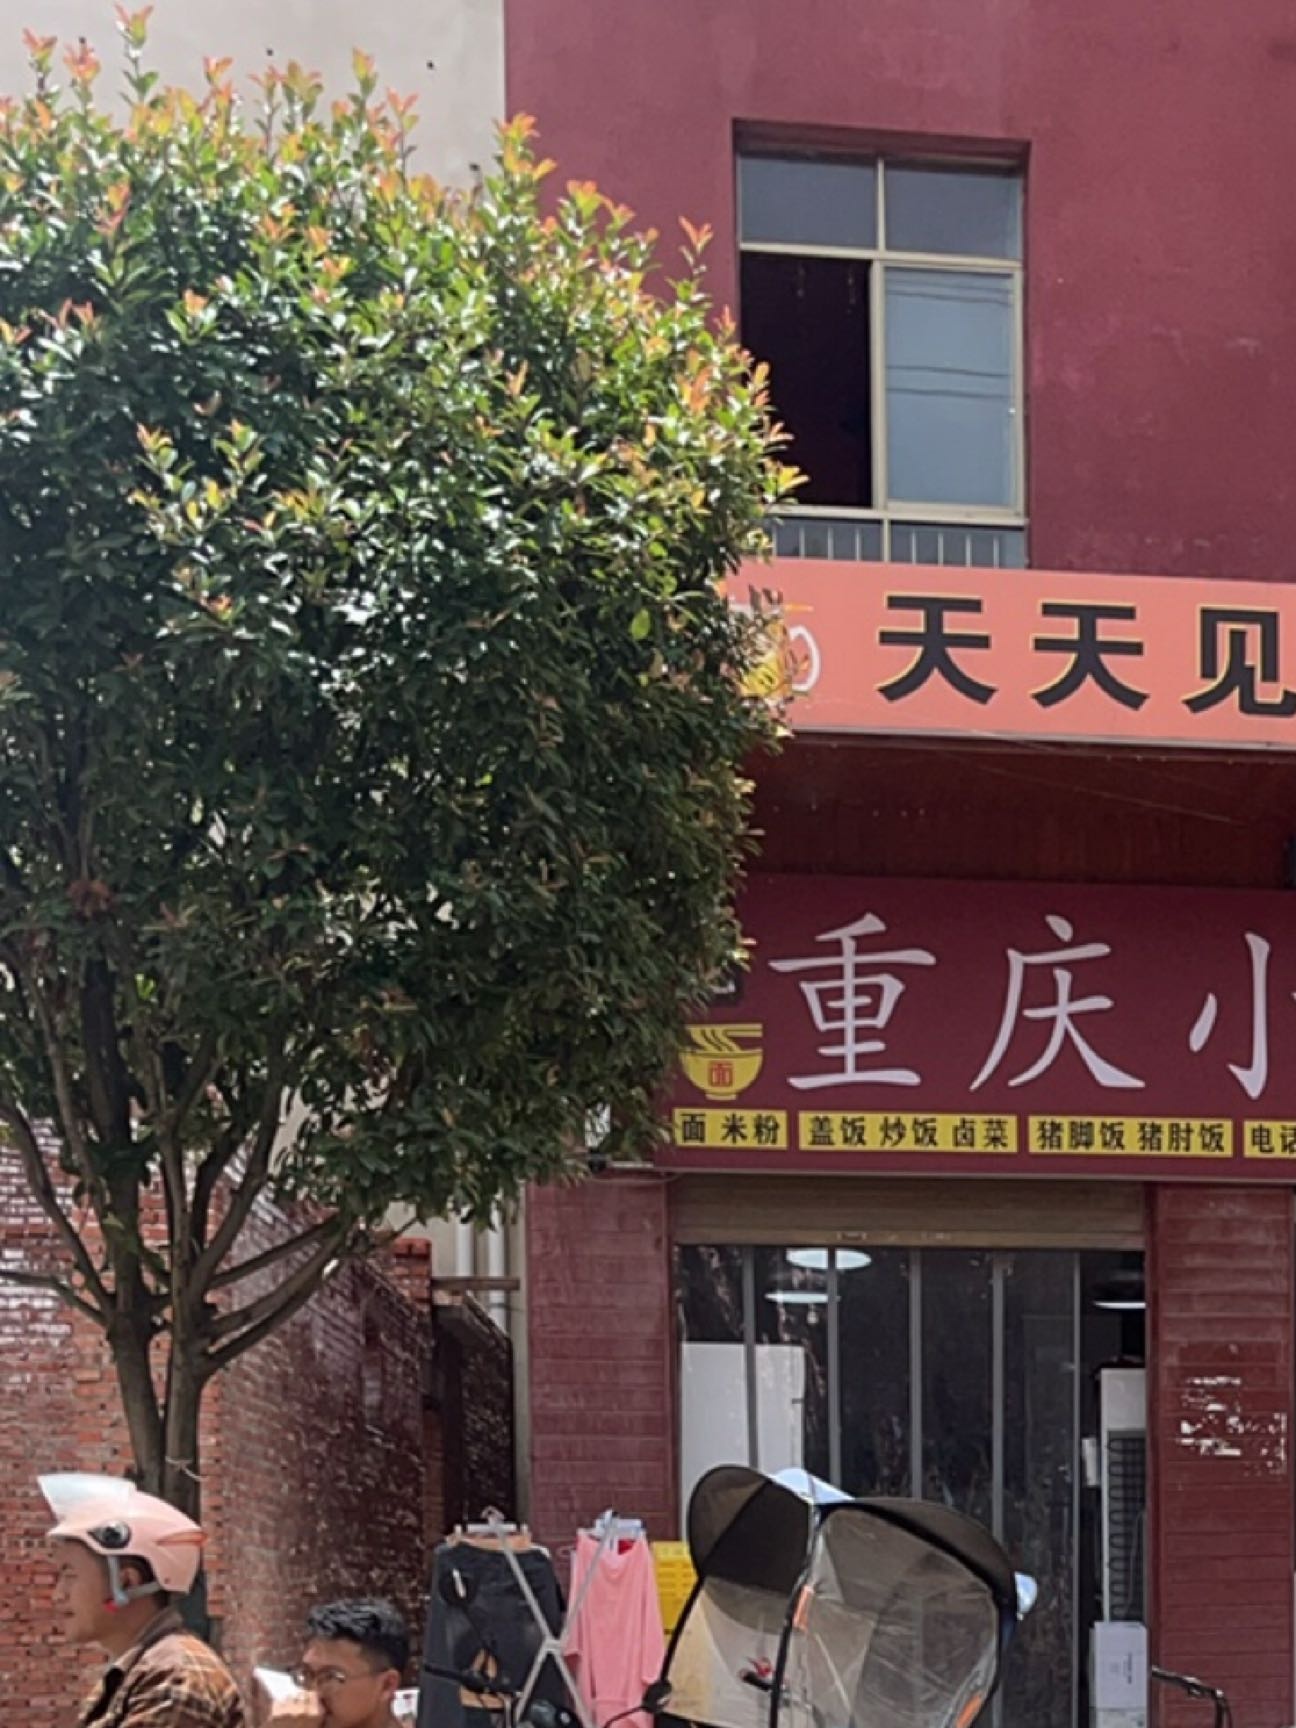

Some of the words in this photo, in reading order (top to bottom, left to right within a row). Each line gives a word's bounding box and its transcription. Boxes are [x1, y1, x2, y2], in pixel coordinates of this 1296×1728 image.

[721, 1112, 781, 1146] 米粉
[809, 1114, 867, 1147] 盖饭
[879, 1115, 938, 1148] 炒饭
[952, 1117, 1008, 1150] 卤菜
[1036, 1119, 1126, 1152] 猪脚饭
[1137, 1121, 1226, 1154] 猪肘饭
